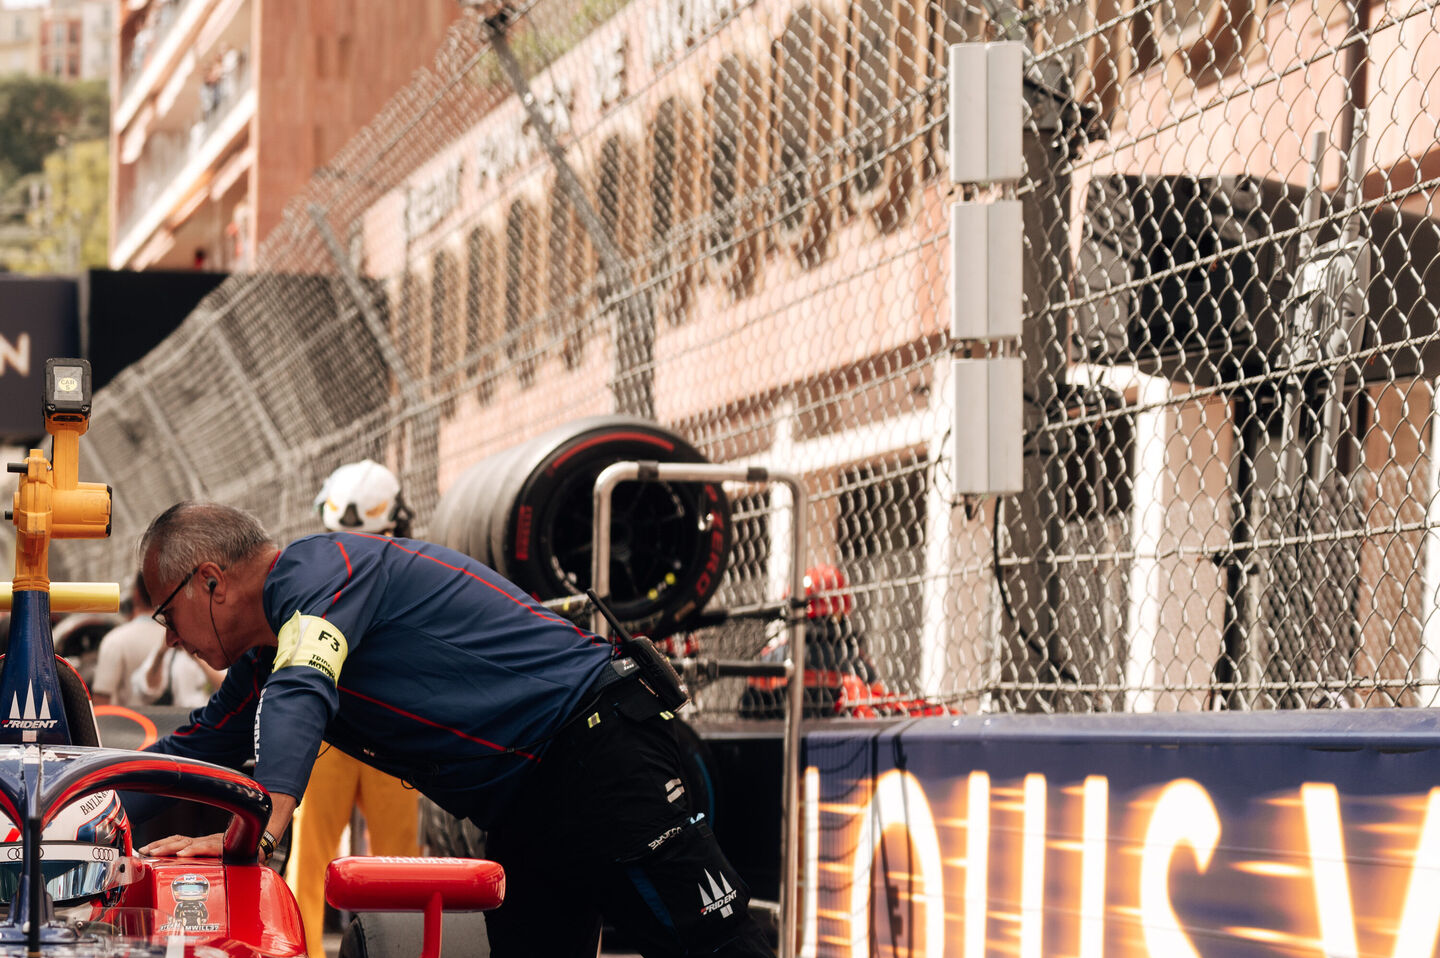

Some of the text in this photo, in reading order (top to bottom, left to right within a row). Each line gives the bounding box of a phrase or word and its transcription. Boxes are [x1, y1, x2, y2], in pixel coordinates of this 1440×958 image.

[317, 630, 341, 653] F3
[0, 719, 58, 729] TRIDENT
[700, 889, 737, 916] TRIDENT
